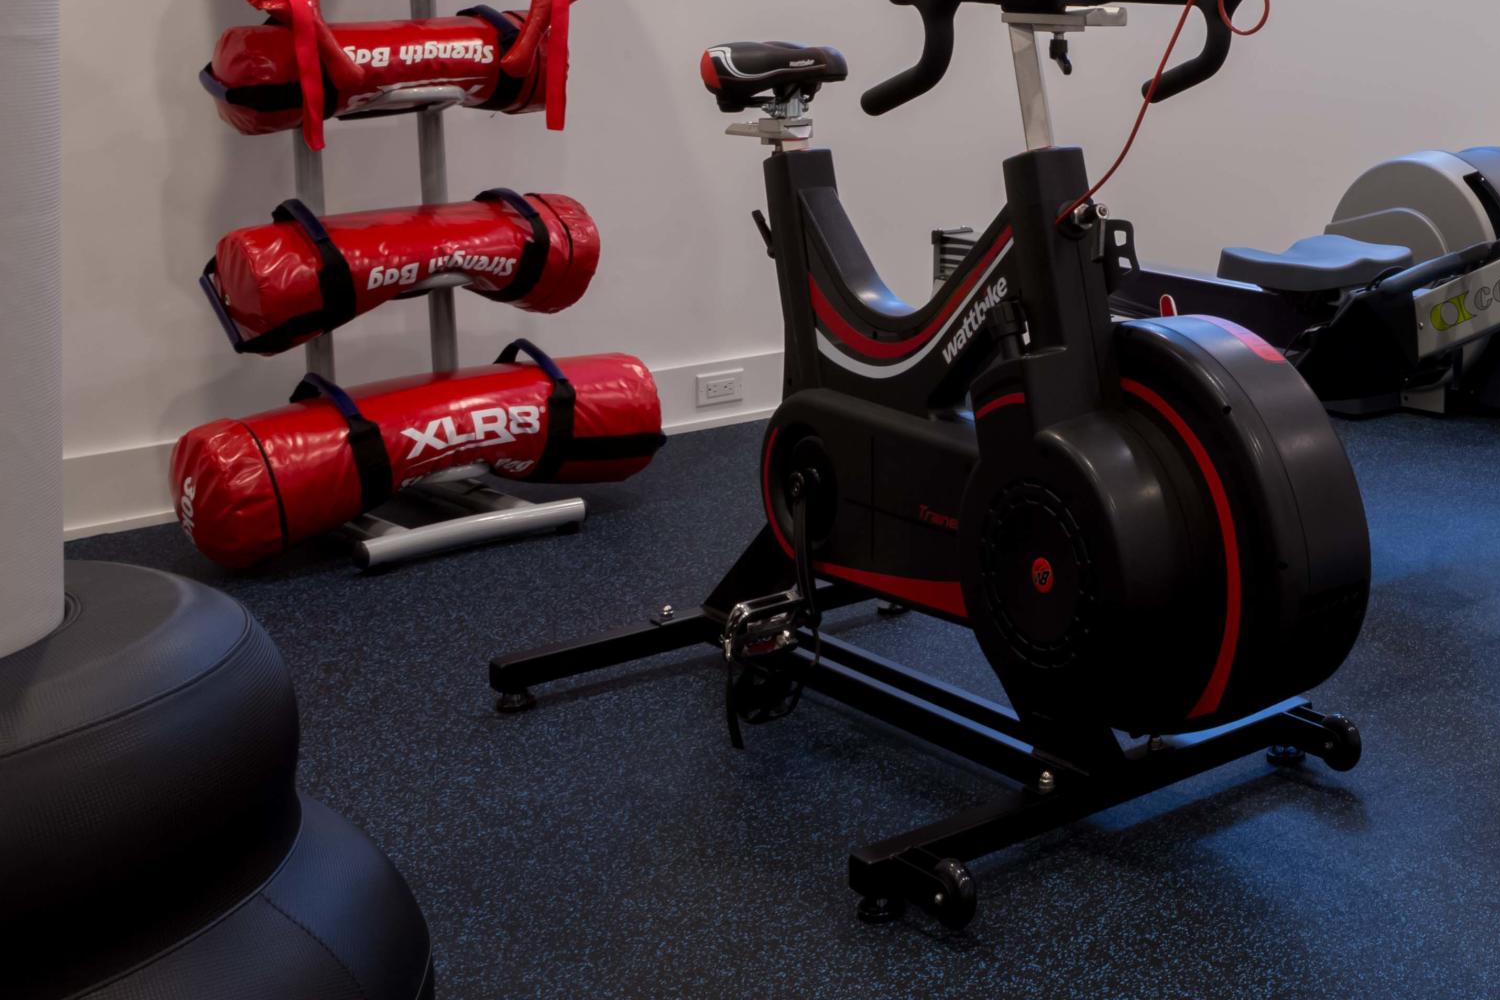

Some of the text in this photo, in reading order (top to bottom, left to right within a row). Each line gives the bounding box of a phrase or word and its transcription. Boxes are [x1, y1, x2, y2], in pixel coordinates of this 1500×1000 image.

[399, 40, 495, 66] Strength
[367, 261, 419, 291] Bag
[941, 277, 1009, 365] wattbike
